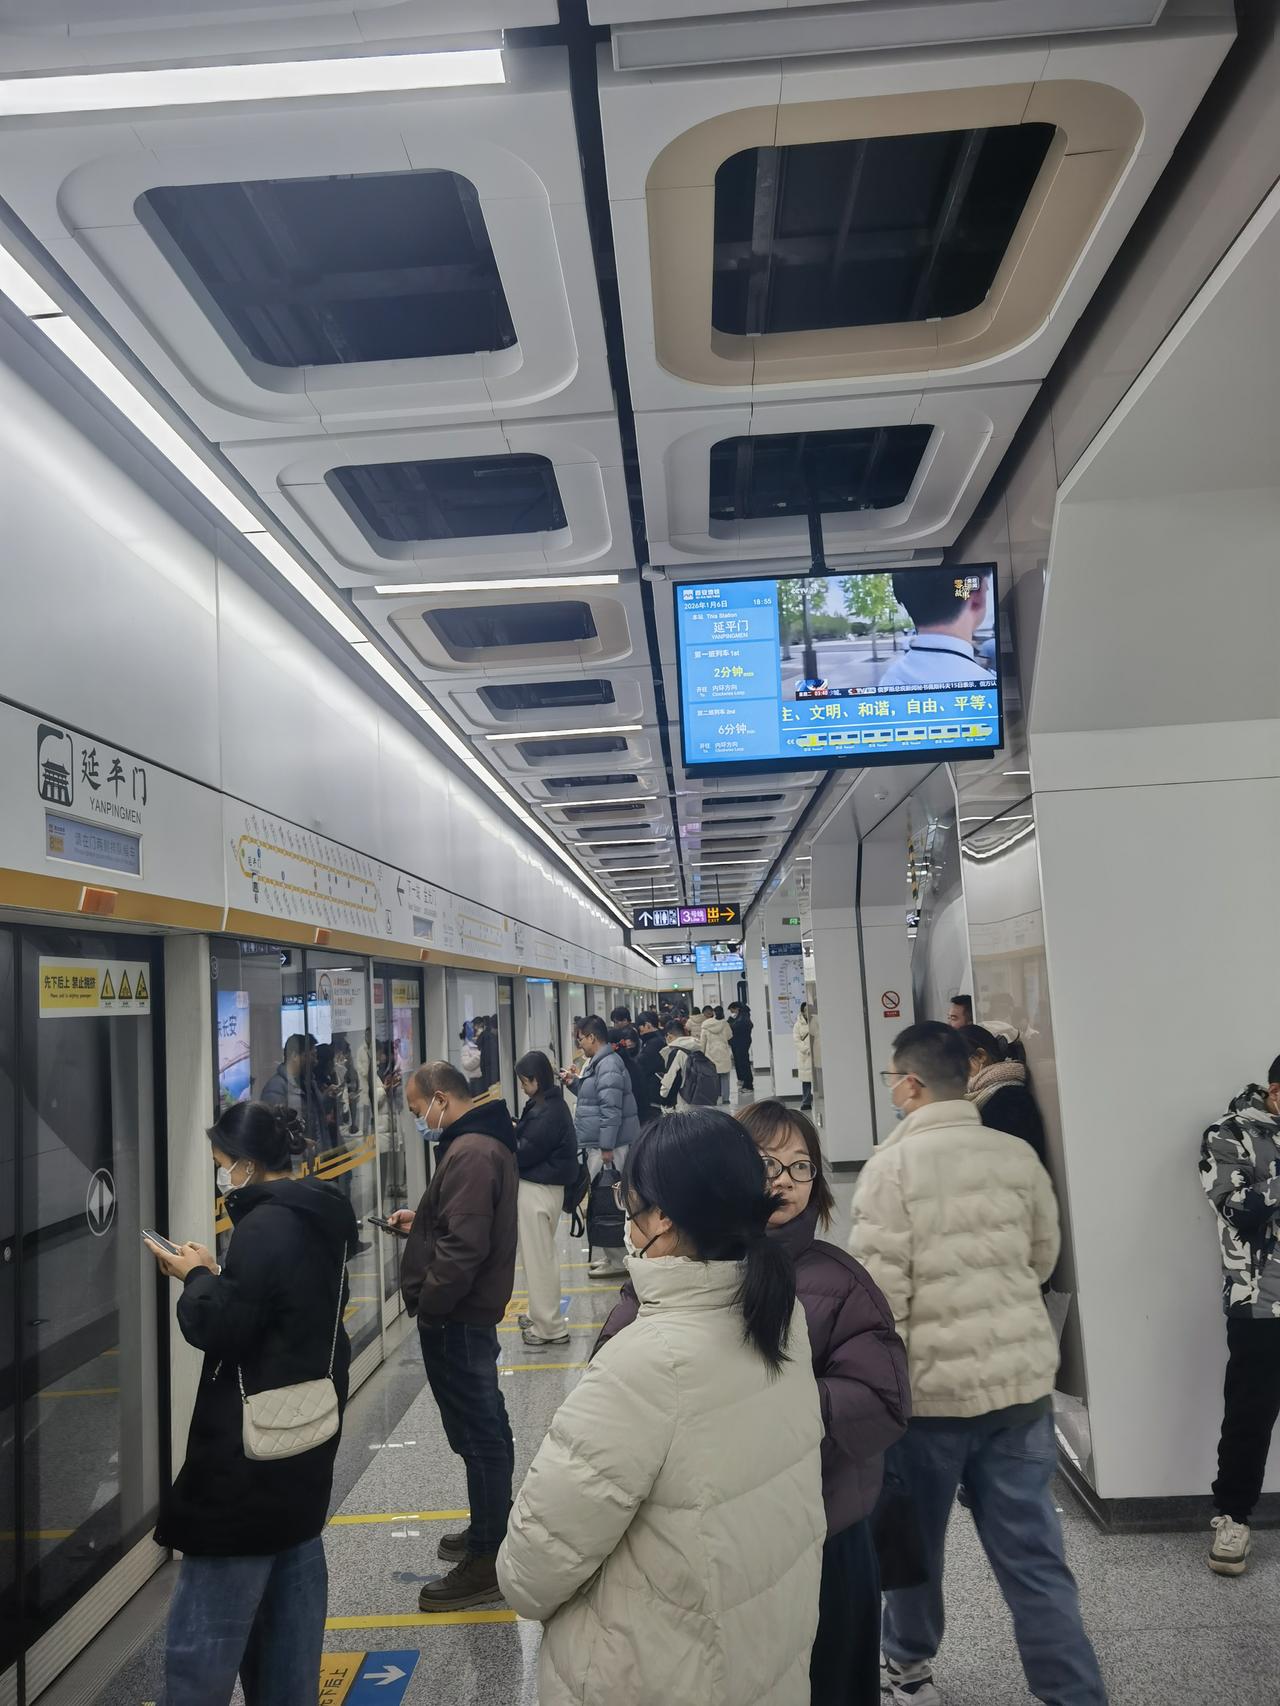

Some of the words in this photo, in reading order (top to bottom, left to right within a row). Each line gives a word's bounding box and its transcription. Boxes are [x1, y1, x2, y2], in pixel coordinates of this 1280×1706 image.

[684, 600, 728, 610] 2026年1月6日
[713, 620, 749, 633] 延平门
[714, 666, 743, 678] 2分钟
[718, 723, 747, 735] 6分钟
[80, 746, 147, 806] 延平门
[90, 796, 142, 824] YANPINGMEN
[708, 907, 719, 918] 出
[44, 975, 70, 989] 先下后上
